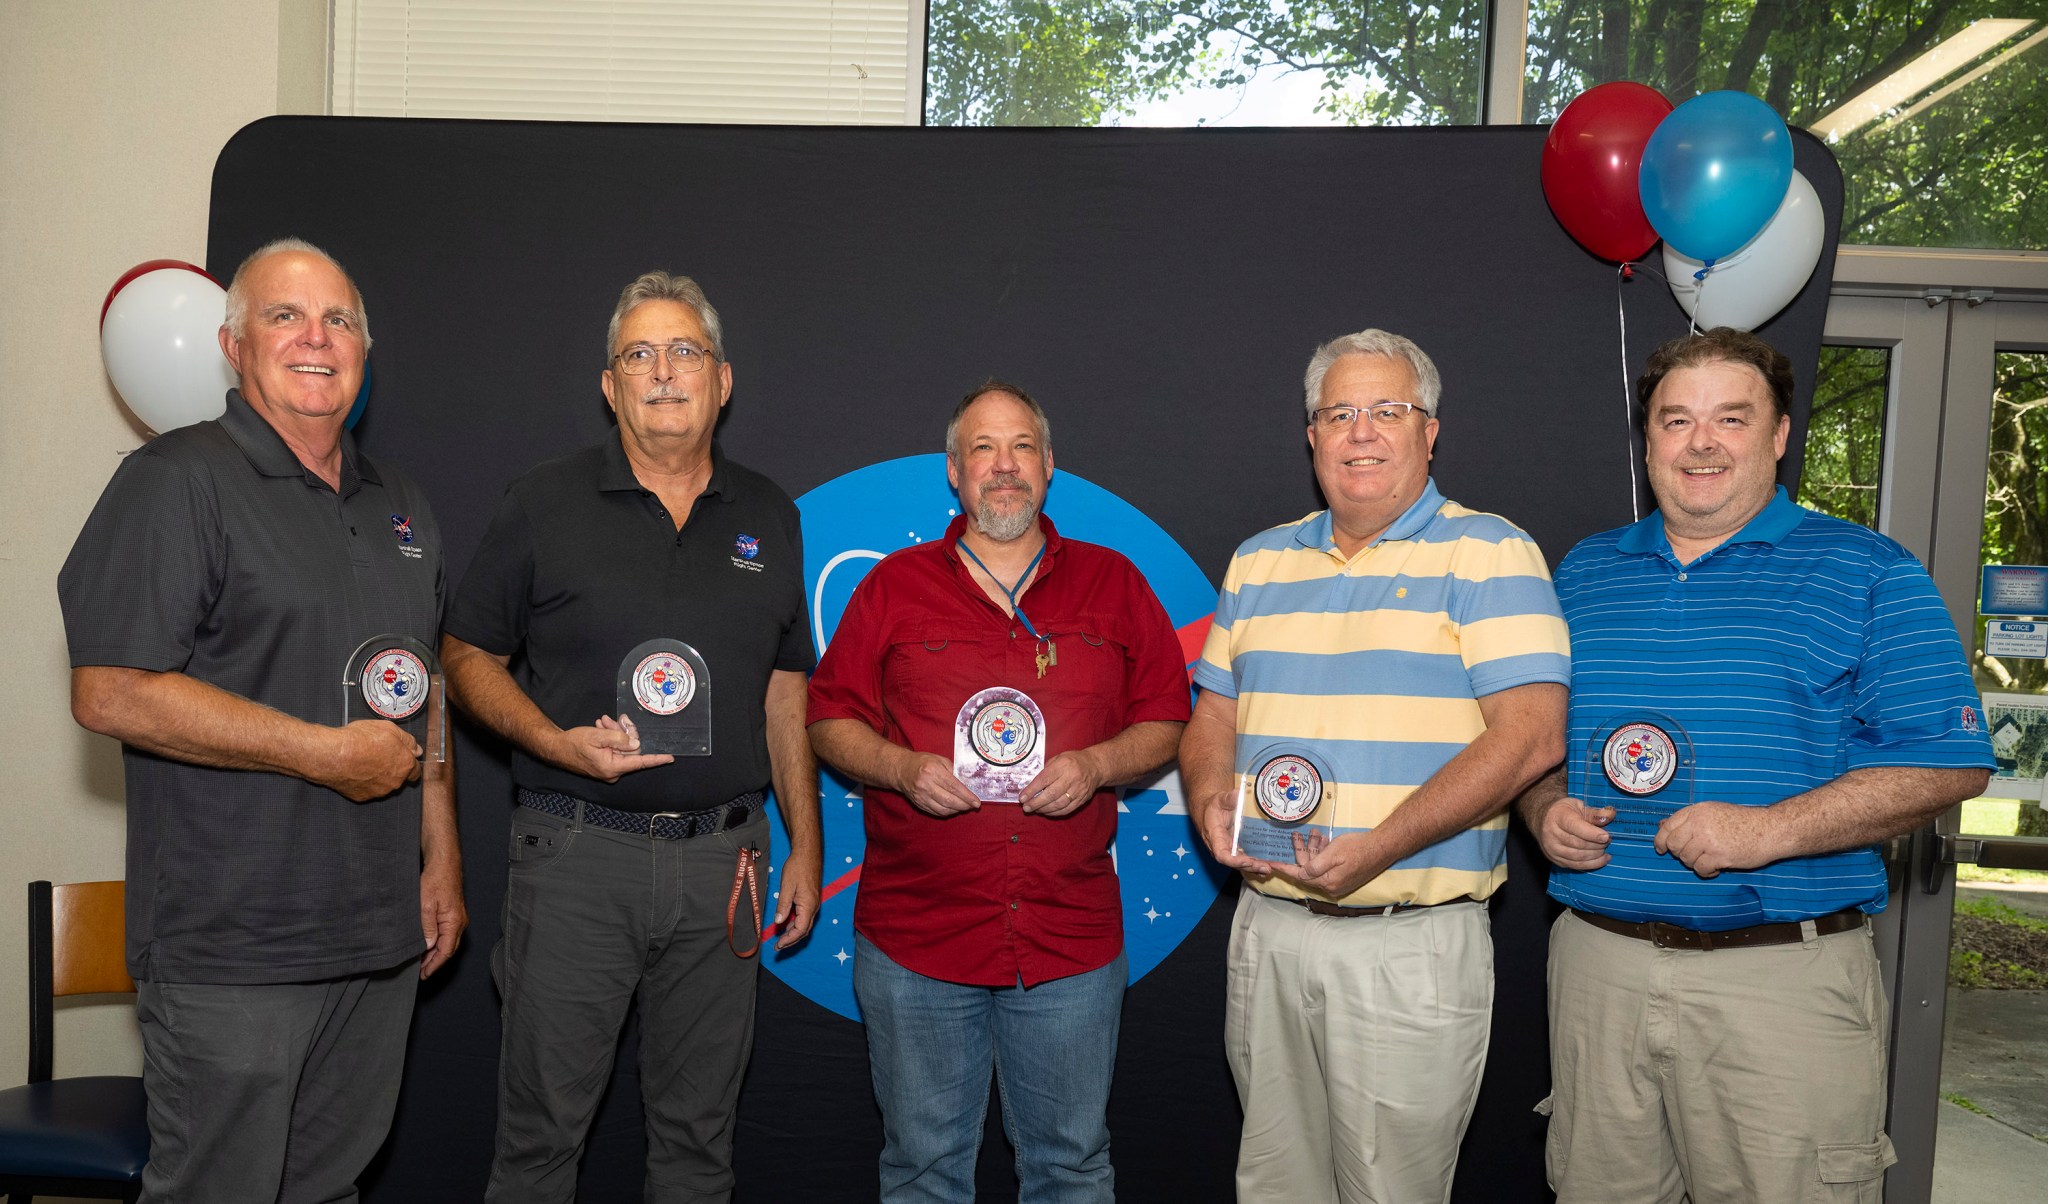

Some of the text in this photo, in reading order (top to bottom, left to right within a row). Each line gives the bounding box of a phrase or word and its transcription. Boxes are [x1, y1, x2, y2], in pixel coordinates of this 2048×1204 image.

[728, 853, 747, 924] HUNTSVILLE RUGBY
[748, 866, 758, 911] HUNTSVILLE
